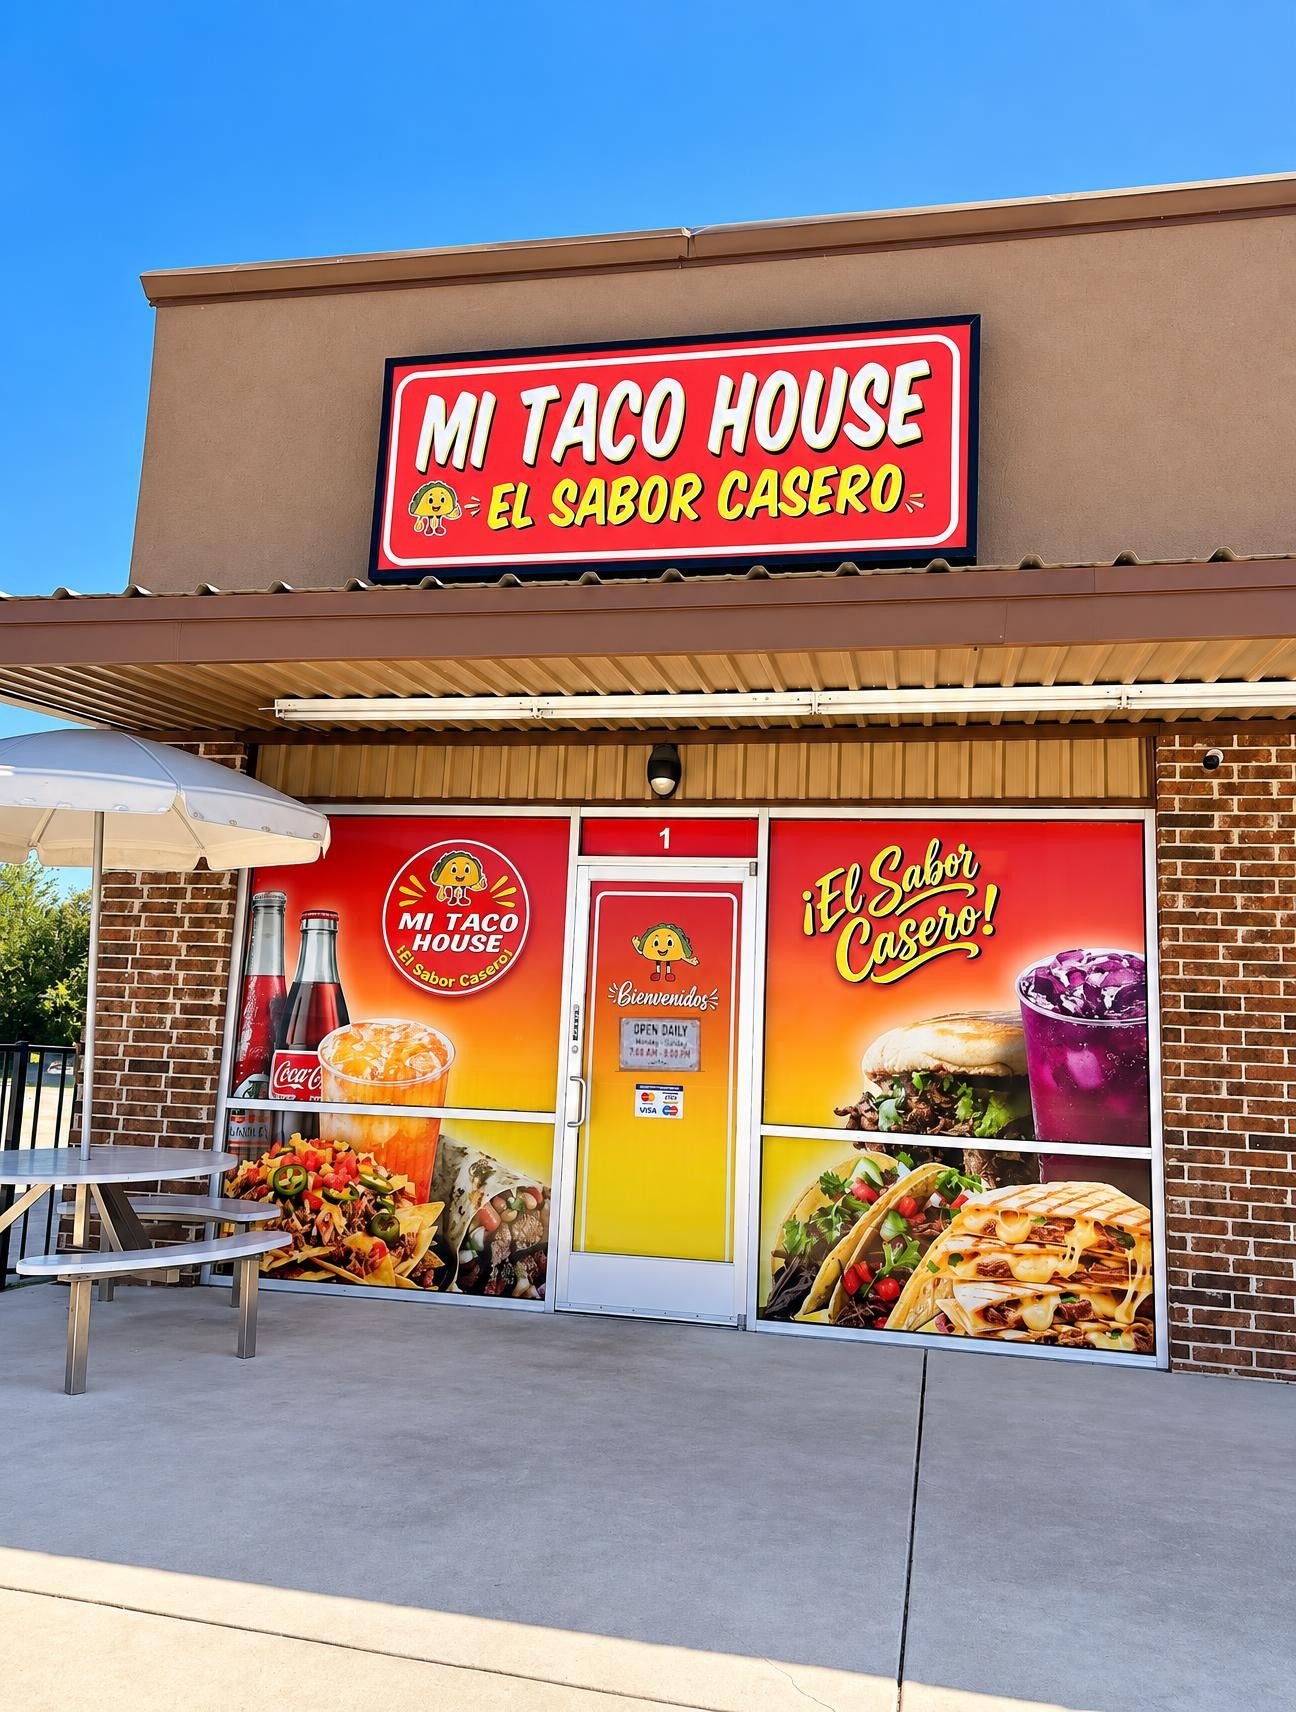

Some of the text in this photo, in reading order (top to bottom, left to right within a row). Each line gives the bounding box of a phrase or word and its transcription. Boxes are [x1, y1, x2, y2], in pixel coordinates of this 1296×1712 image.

[414, 359, 931, 473] MI TACO HOUSE
[486, 463, 904, 531] EL SABOR CASERO
[659, 827, 671, 850] 1
[802, 838, 979, 936] ¡El Sabor
[398, 912, 519, 933] MI TACO
[836, 884, 999, 983] Casero!
[412, 934, 504, 953] HOUSE
[412, 963, 456, 988] Sabor
[617, 980, 709, 1011] Bienvenidos
[634, 1022, 688, 1037] OPEN DAILY
[273, 1060, 322, 1091] Coca-C
